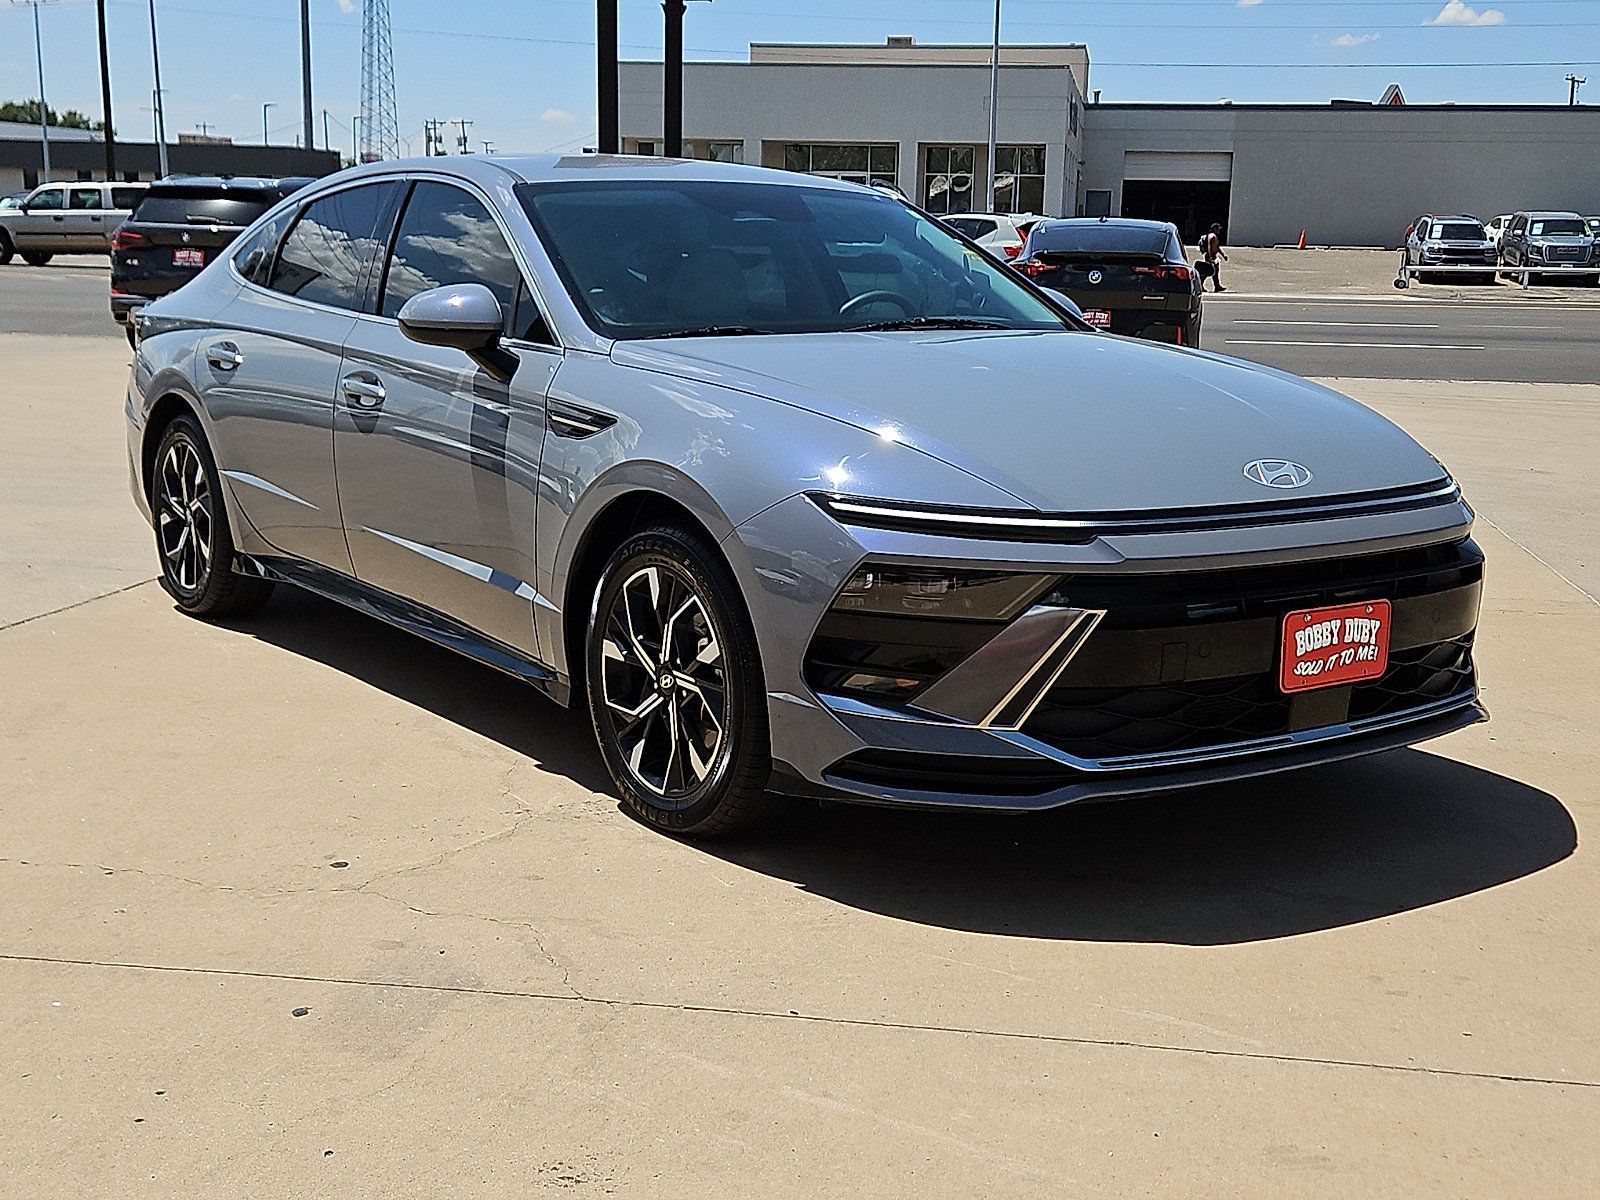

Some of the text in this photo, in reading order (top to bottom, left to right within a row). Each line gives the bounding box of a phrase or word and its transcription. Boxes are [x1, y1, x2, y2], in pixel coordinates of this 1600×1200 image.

[1295, 617, 1380, 657] BOBBY DUBY
[1293, 644, 1379, 676] SOLD IT TO ME!
